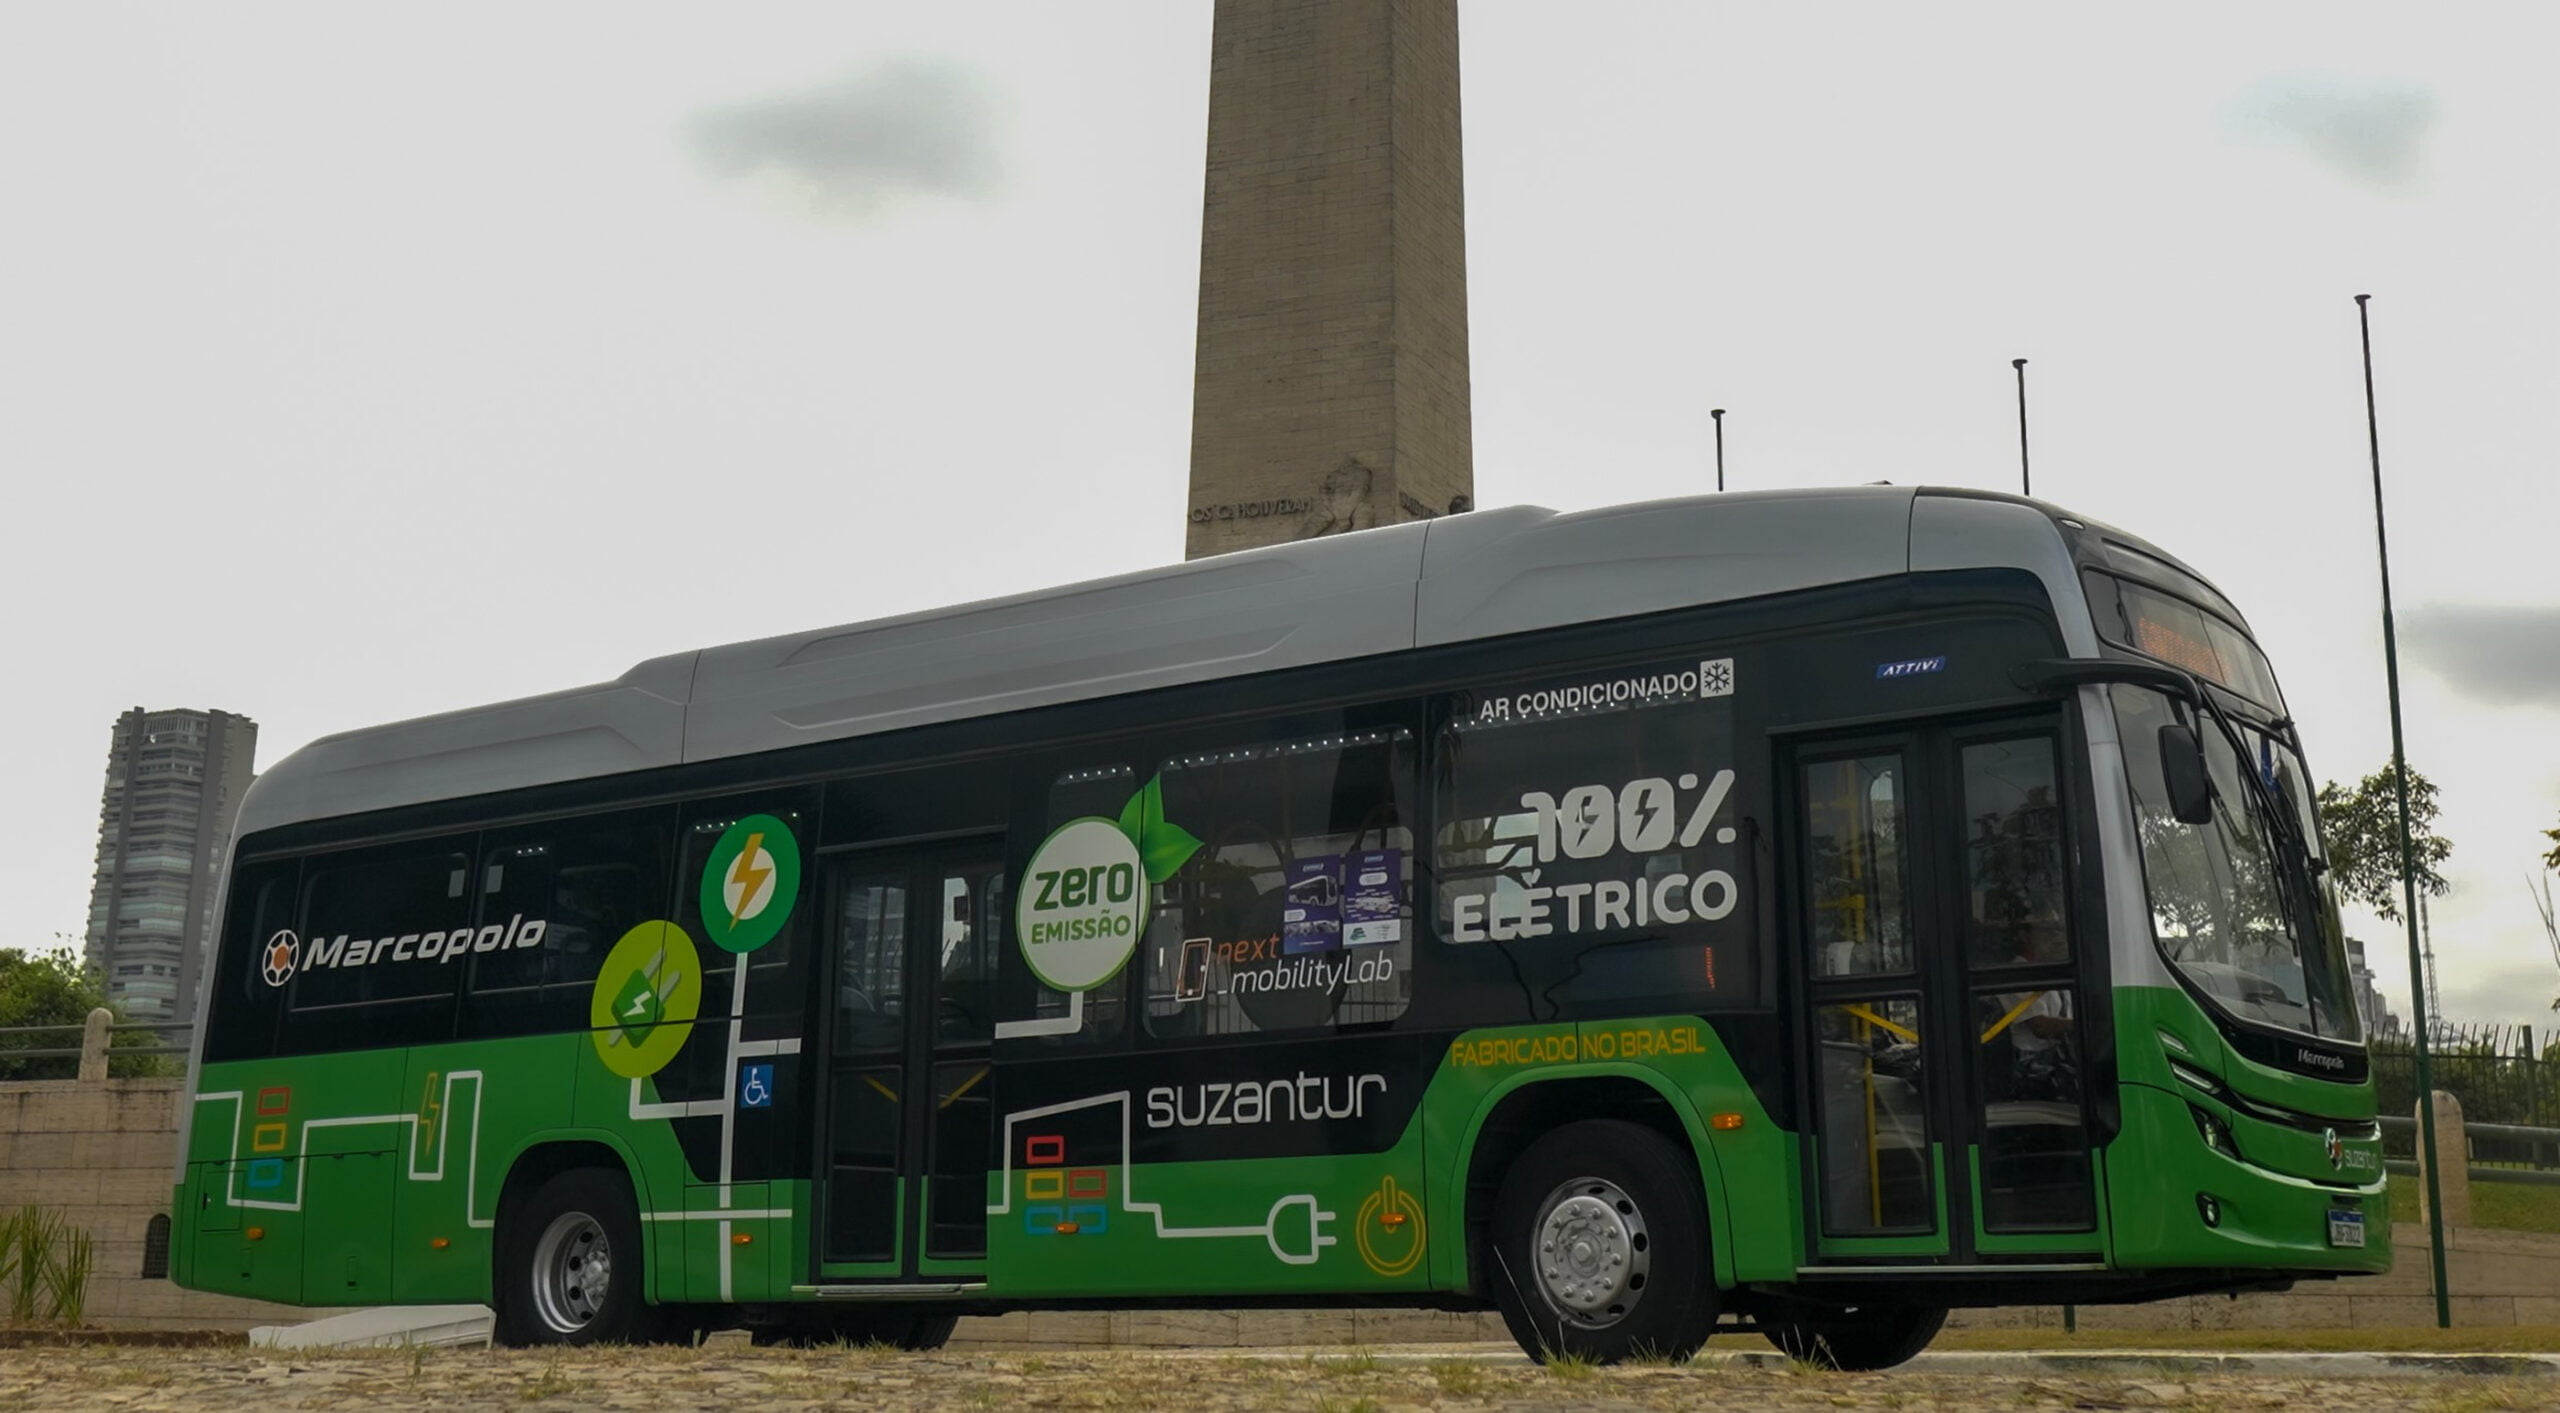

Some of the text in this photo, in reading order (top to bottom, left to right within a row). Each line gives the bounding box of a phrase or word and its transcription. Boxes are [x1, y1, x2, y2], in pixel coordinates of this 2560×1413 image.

[1479, 671, 1698, 721] AR CONDICIONADO
[1520, 769, 1737, 863] 100%
[1033, 862, 1134, 912] zero
[1453, 868, 1738, 943] ELÉTRICO
[301, 913, 547, 972] Marcopolo
[1031, 908, 1132, 945] EMISSÃO
[1215, 932, 1281, 964] next
[1451, 1027, 1707, 1067] FABRICADO NO BRASIL
[1146, 1071, 1388, 1129] suzantur
